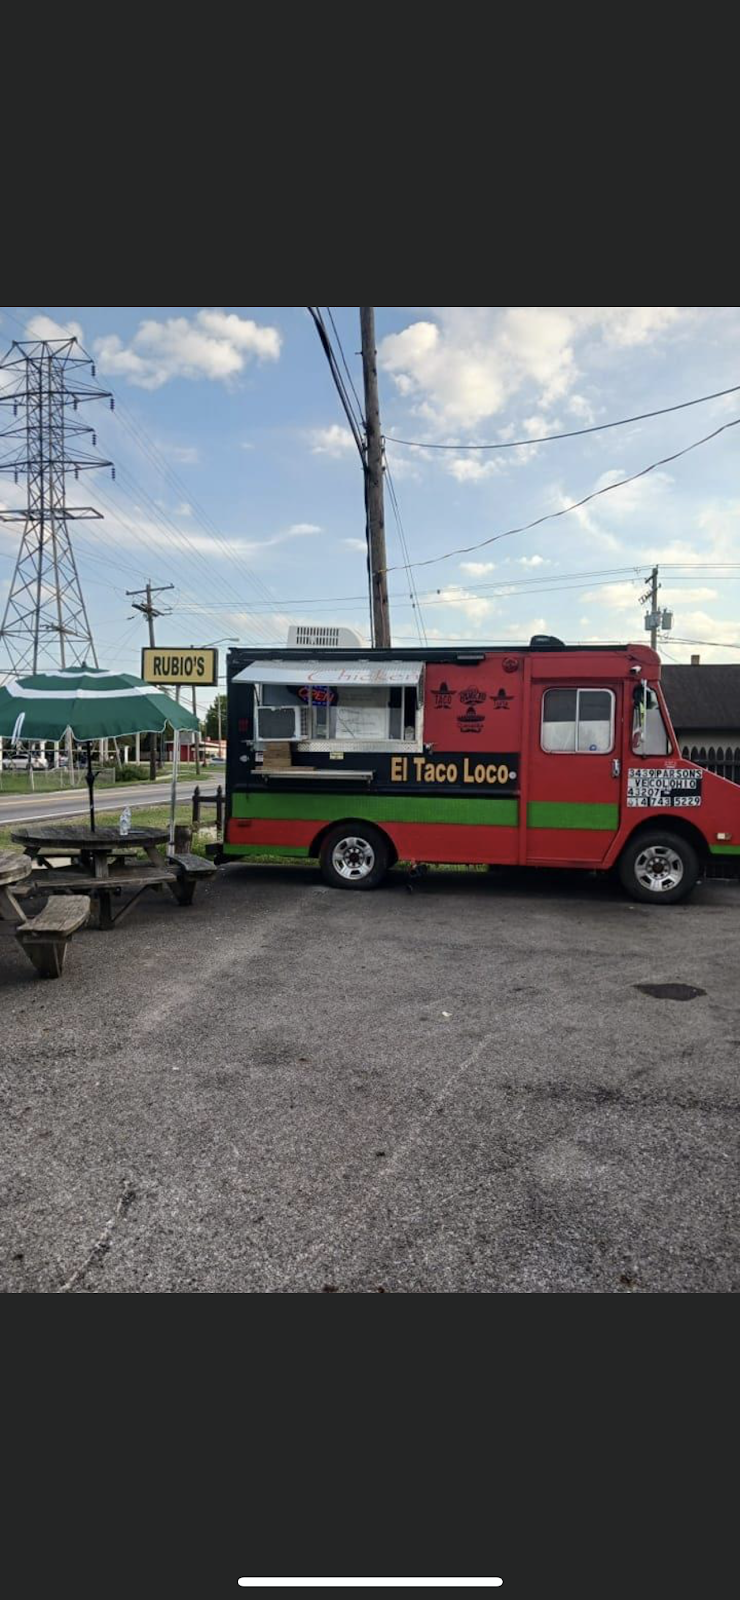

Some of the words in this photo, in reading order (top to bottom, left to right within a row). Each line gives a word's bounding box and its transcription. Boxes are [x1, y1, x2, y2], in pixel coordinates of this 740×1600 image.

[153, 656, 205, 677] RUBIO'S
[298, 688, 335, 702] OPEN
[435, 694, 452, 705] TACO
[391, 757, 408, 782] El
[413, 757, 458, 783] Taco
[463, 758, 509, 784] Loco
[629, 769, 655, 778] 3439
[656, 769, 702, 778] PARSONS
[627, 788, 660, 797] 43207
[650, 797, 671, 806] 743
[674, 797, 701, 806] 5229
